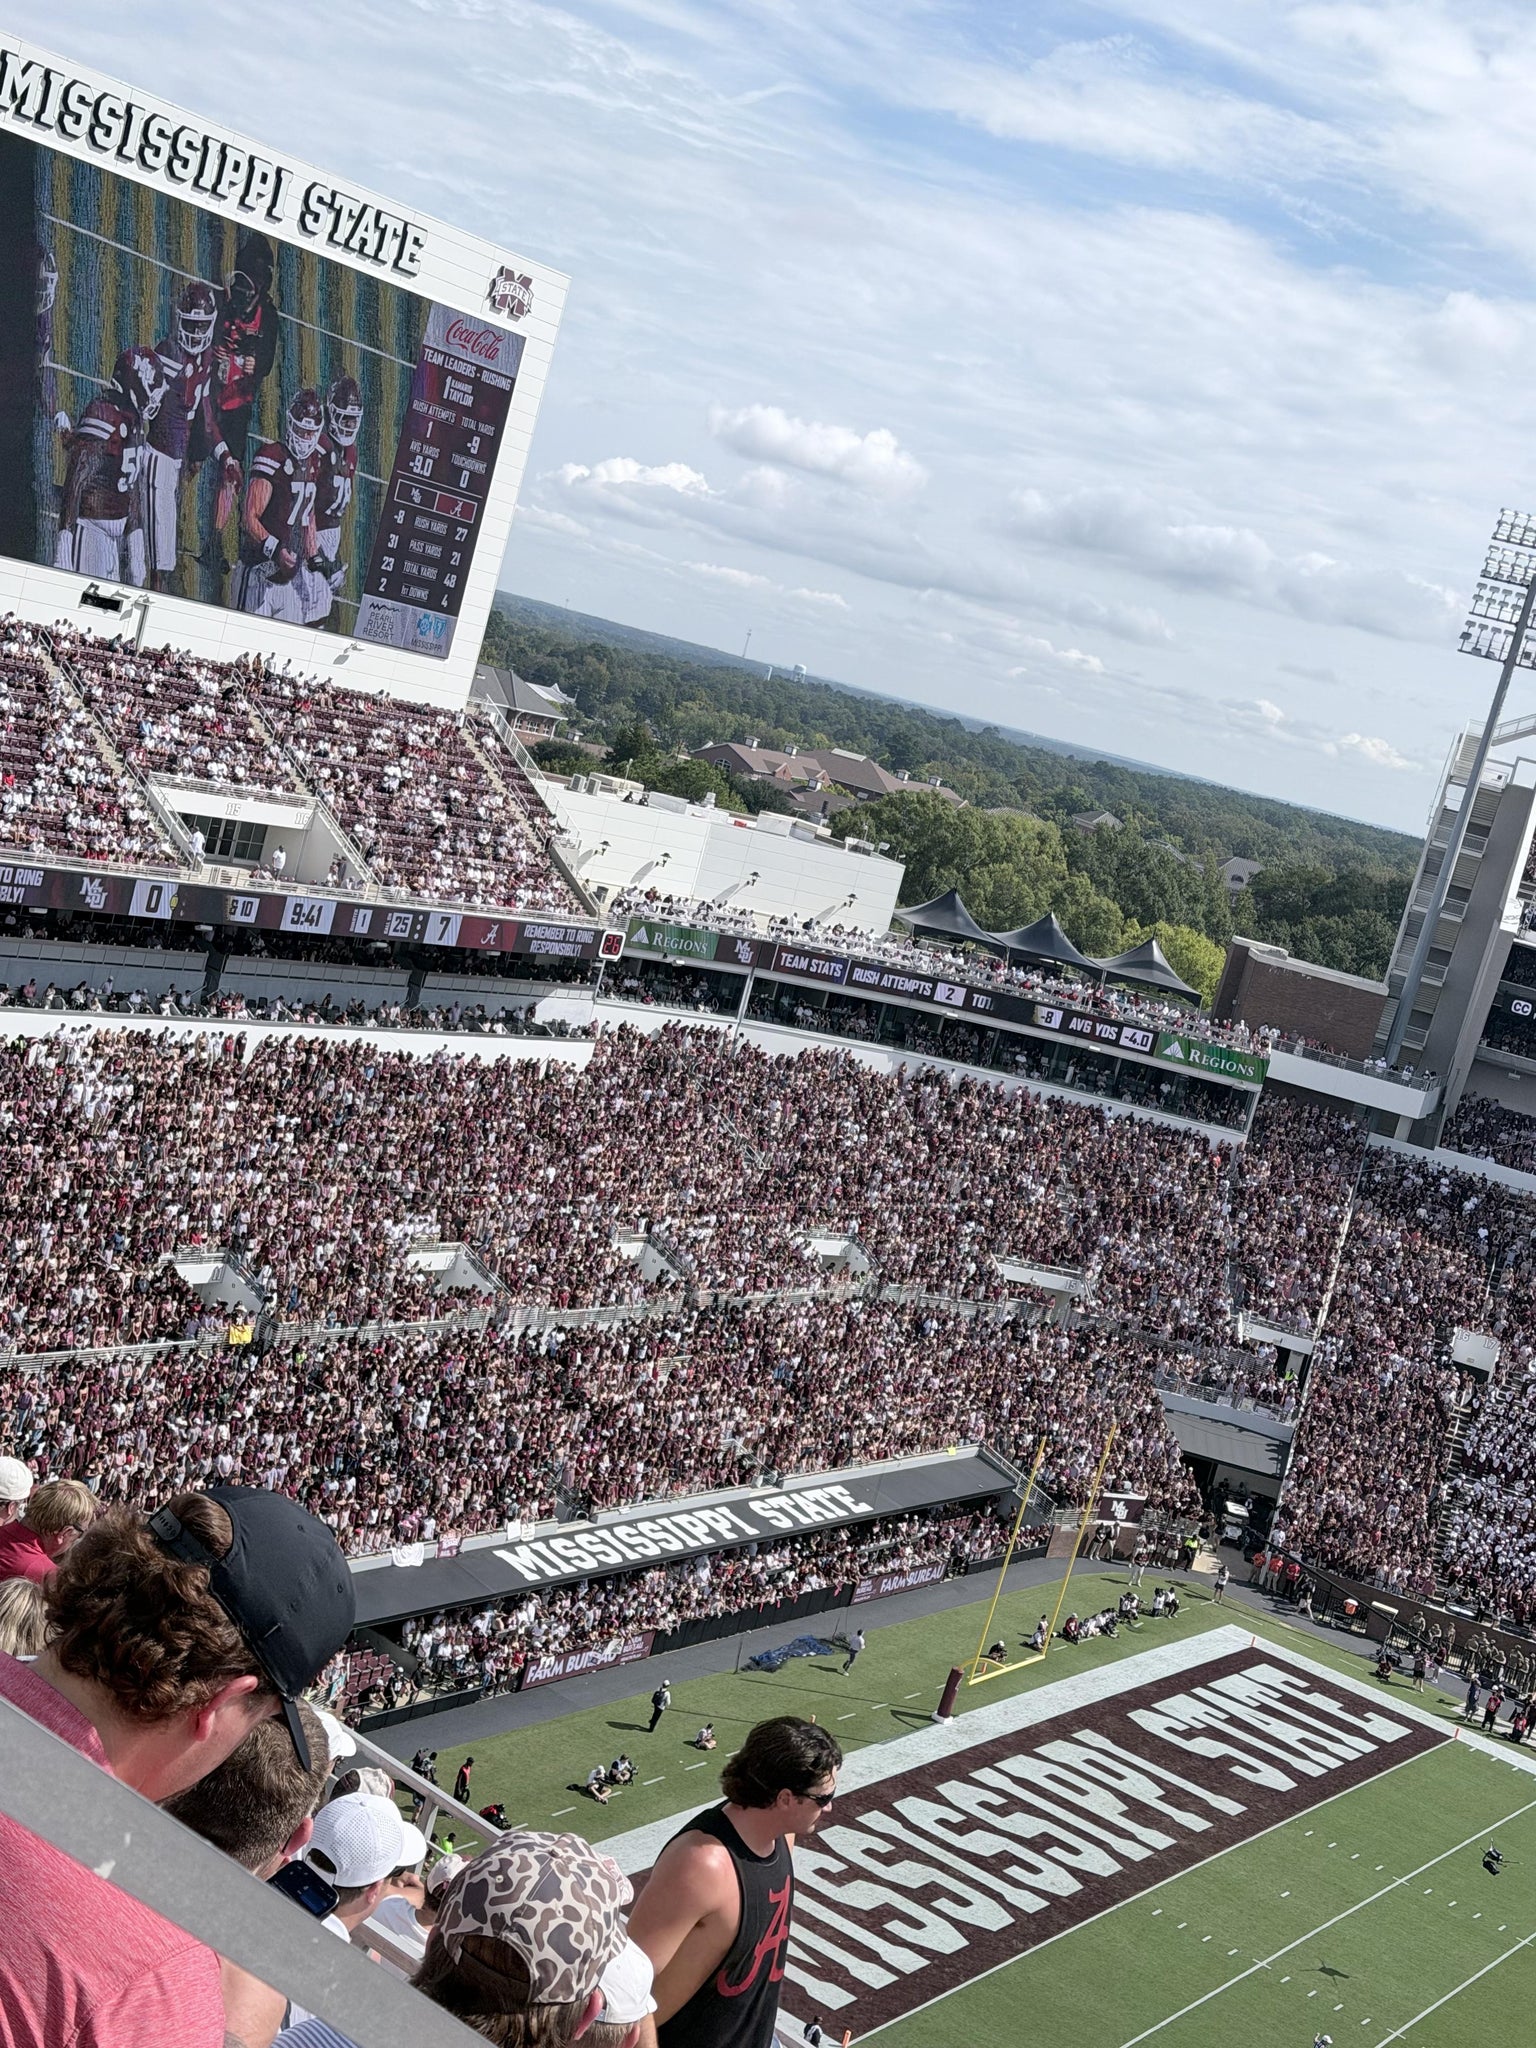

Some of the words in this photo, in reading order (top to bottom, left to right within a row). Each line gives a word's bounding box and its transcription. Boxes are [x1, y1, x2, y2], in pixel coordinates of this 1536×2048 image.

[0, 49, 293, 222] MISSISSIPPI
[298, 181, 428, 278] STATE
[501, 283, 528, 303] STATE
[423, 348, 445, 367] TEAM
[444, 356, 476, 378] LEADERS
[481, 370, 512, 391] RUSHING
[443, 375, 452, 399] 1
[449, 388, 474, 407] TAYLOR
[412, 400, 429, 414] RUSH
[428, 404, 456, 423] ATTEMPTS
[426, 421, 433, 439] 1
[461, 416, 478, 431] TOTAL
[477, 421, 496, 437] YARDS
[410, 440, 421, 452] AVG
[421, 444, 440, 458] YARDS
[466, 435, 481, 455] -9
[409, 454, 433, 477] -9.0
[451, 453, 487, 475] TOUCHDOWNS
[459, 470, 470, 489] 0
[394, 510, 405, 524] -8
[414, 515, 430, 530] RUSH
[429, 519, 448, 534] YARDS
[455, 527, 468, 542] 27
[387, 534, 399, 549] 31
[409, 539, 424, 553] PASS
[423, 542, 443, 557] YARDS
[450, 551, 461, 566] 21
[381, 556, 395, 572] 23
[402, 560, 420, 575] TOTAL
[420, 564, 438, 580] YARDS
[443, 573, 457, 588] 48
[378, 578, 388, 592] 2
[408, 587, 429, 601] DOWNS
[440, 594, 448, 607] 4
[366, 619, 394, 632] RIVER
[369, 611, 394, 625] PEARL
[362, 628, 395, 640] RESORT
[411, 638, 443, 652] MISSISSIPPI
[225, 803, 241, 816] 115
[295, 812, 309, 825] 116
[14, 868, 45, 887] RING
[145, 884, 163, 913] 0
[240, 900, 254, 917] 10
[290, 903, 324, 927] 9:41
[392, 916, 410, 933] 25
[437, 916, 451, 941] 7
[523, 924, 565, 942] REMEMBER
[565, 928, 577, 941] TO
[576, 929, 594, 943] RING
[530, 940, 583, 957] RESPONSIBLY!
[603, 936, 620, 954] 26
[652, 932, 708, 954] REGIONS
[780, 952, 808, 971] TEAM
[809, 958, 843, 978] STATS
[852, 967, 880, 985] RUSH
[879, 975, 933, 996] ATTEMPTS
[944, 987, 955, 1000] 2
[1040, 1011, 1054, 1024] -8
[1068, 1016, 1094, 1034] AVG
[1094, 1022, 1119, 1041] YDS
[1124, 1032, 1150, 1048] -4.0
[1188, 1048, 1255, 1077] REGIONS
[1064, 1280, 1077, 1290] 15
[1457, 1330, 1470, 1342] 16
[1483, 1339, 1497, 1350] 17
[492, 1505, 760, 1581] MISSISSIPPI
[748, 1484, 874, 1529] STATE
[880, 1574, 906, 1593] FARM
[1126, 1663, 1413, 1792] STATE
[717, 1874, 791, 1998] A
